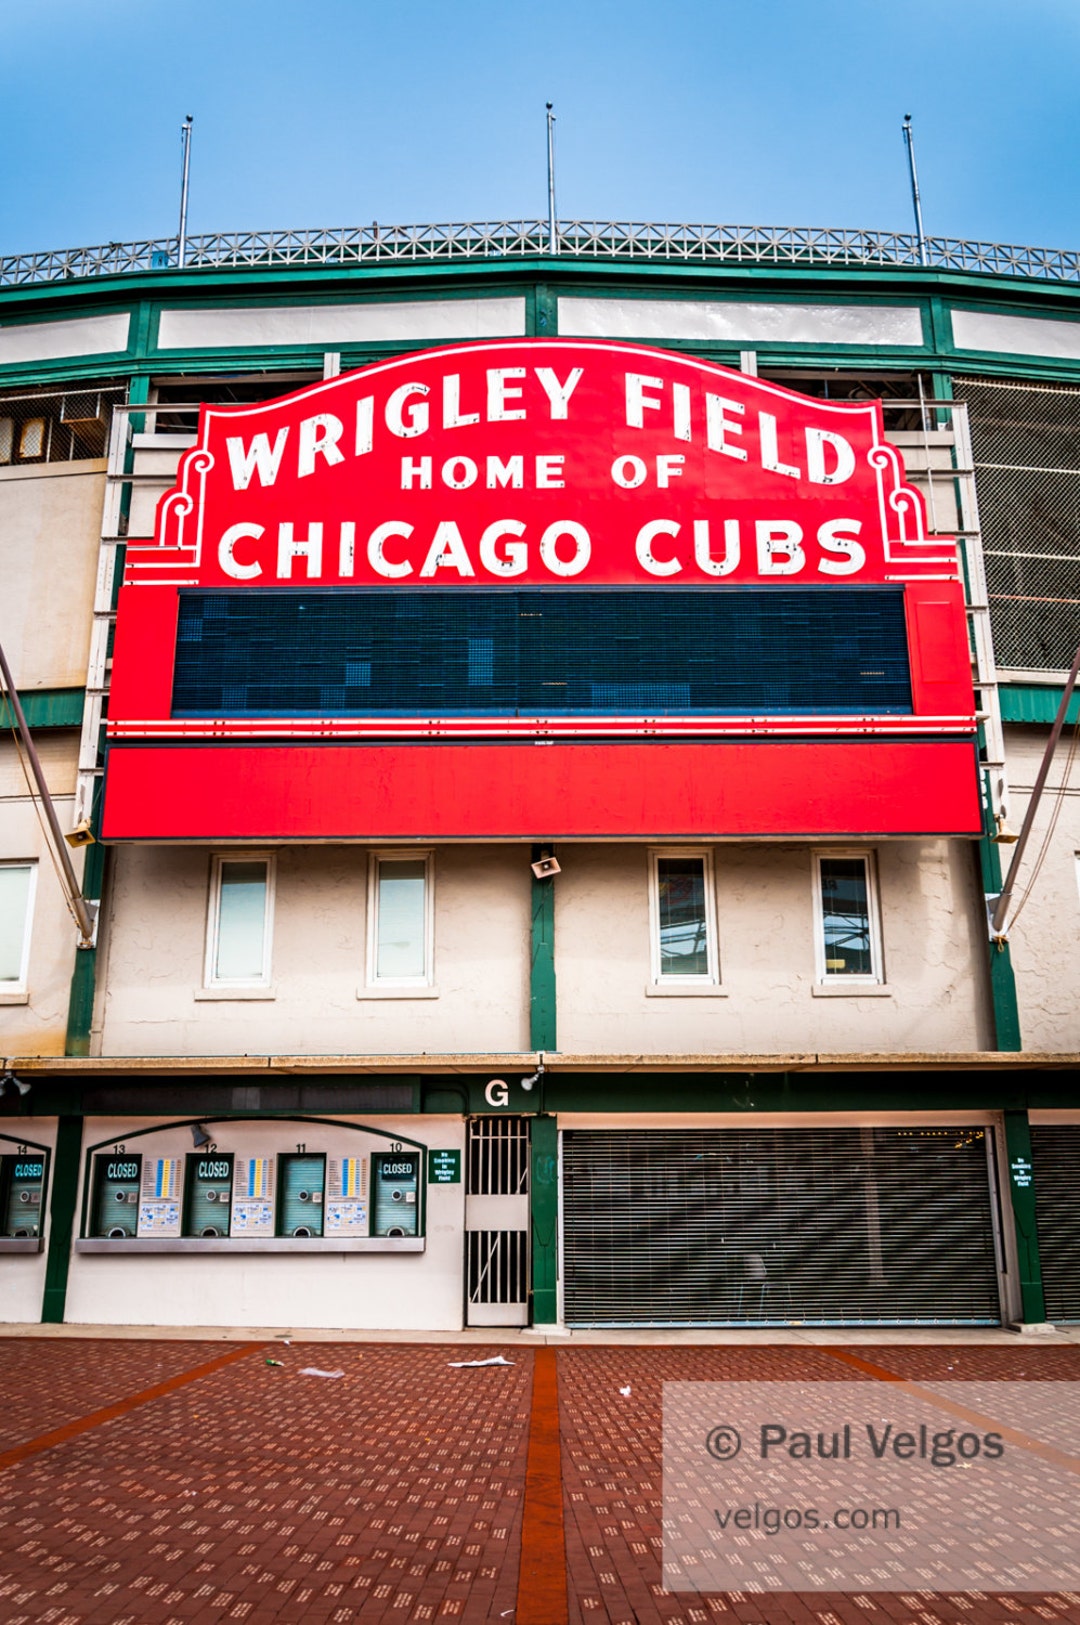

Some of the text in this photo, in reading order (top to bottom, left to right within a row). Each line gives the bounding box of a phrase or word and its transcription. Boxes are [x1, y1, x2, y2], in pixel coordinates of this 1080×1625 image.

[226, 366, 857, 491] WRIGLEY FIELD
[401, 453, 686, 490] HOME OF
[217, 517, 867, 581] CHICAGO CUBS
[485, 1079, 509, 1107] G
[17, 1145, 28, 1155] 14
[113, 1144, 126, 1154] 13
[205, 1143, 218, 1153] 12
[296, 1143, 306, 1153] 11
[390, 1142, 403, 1152] 10
[15, 1164, 43, 1177] CLOSED
[107, 1163, 138, 1178] CLOSED
[198, 1161, 229, 1177] CLOSED
[383, 1163, 413, 1175] CLOSED
